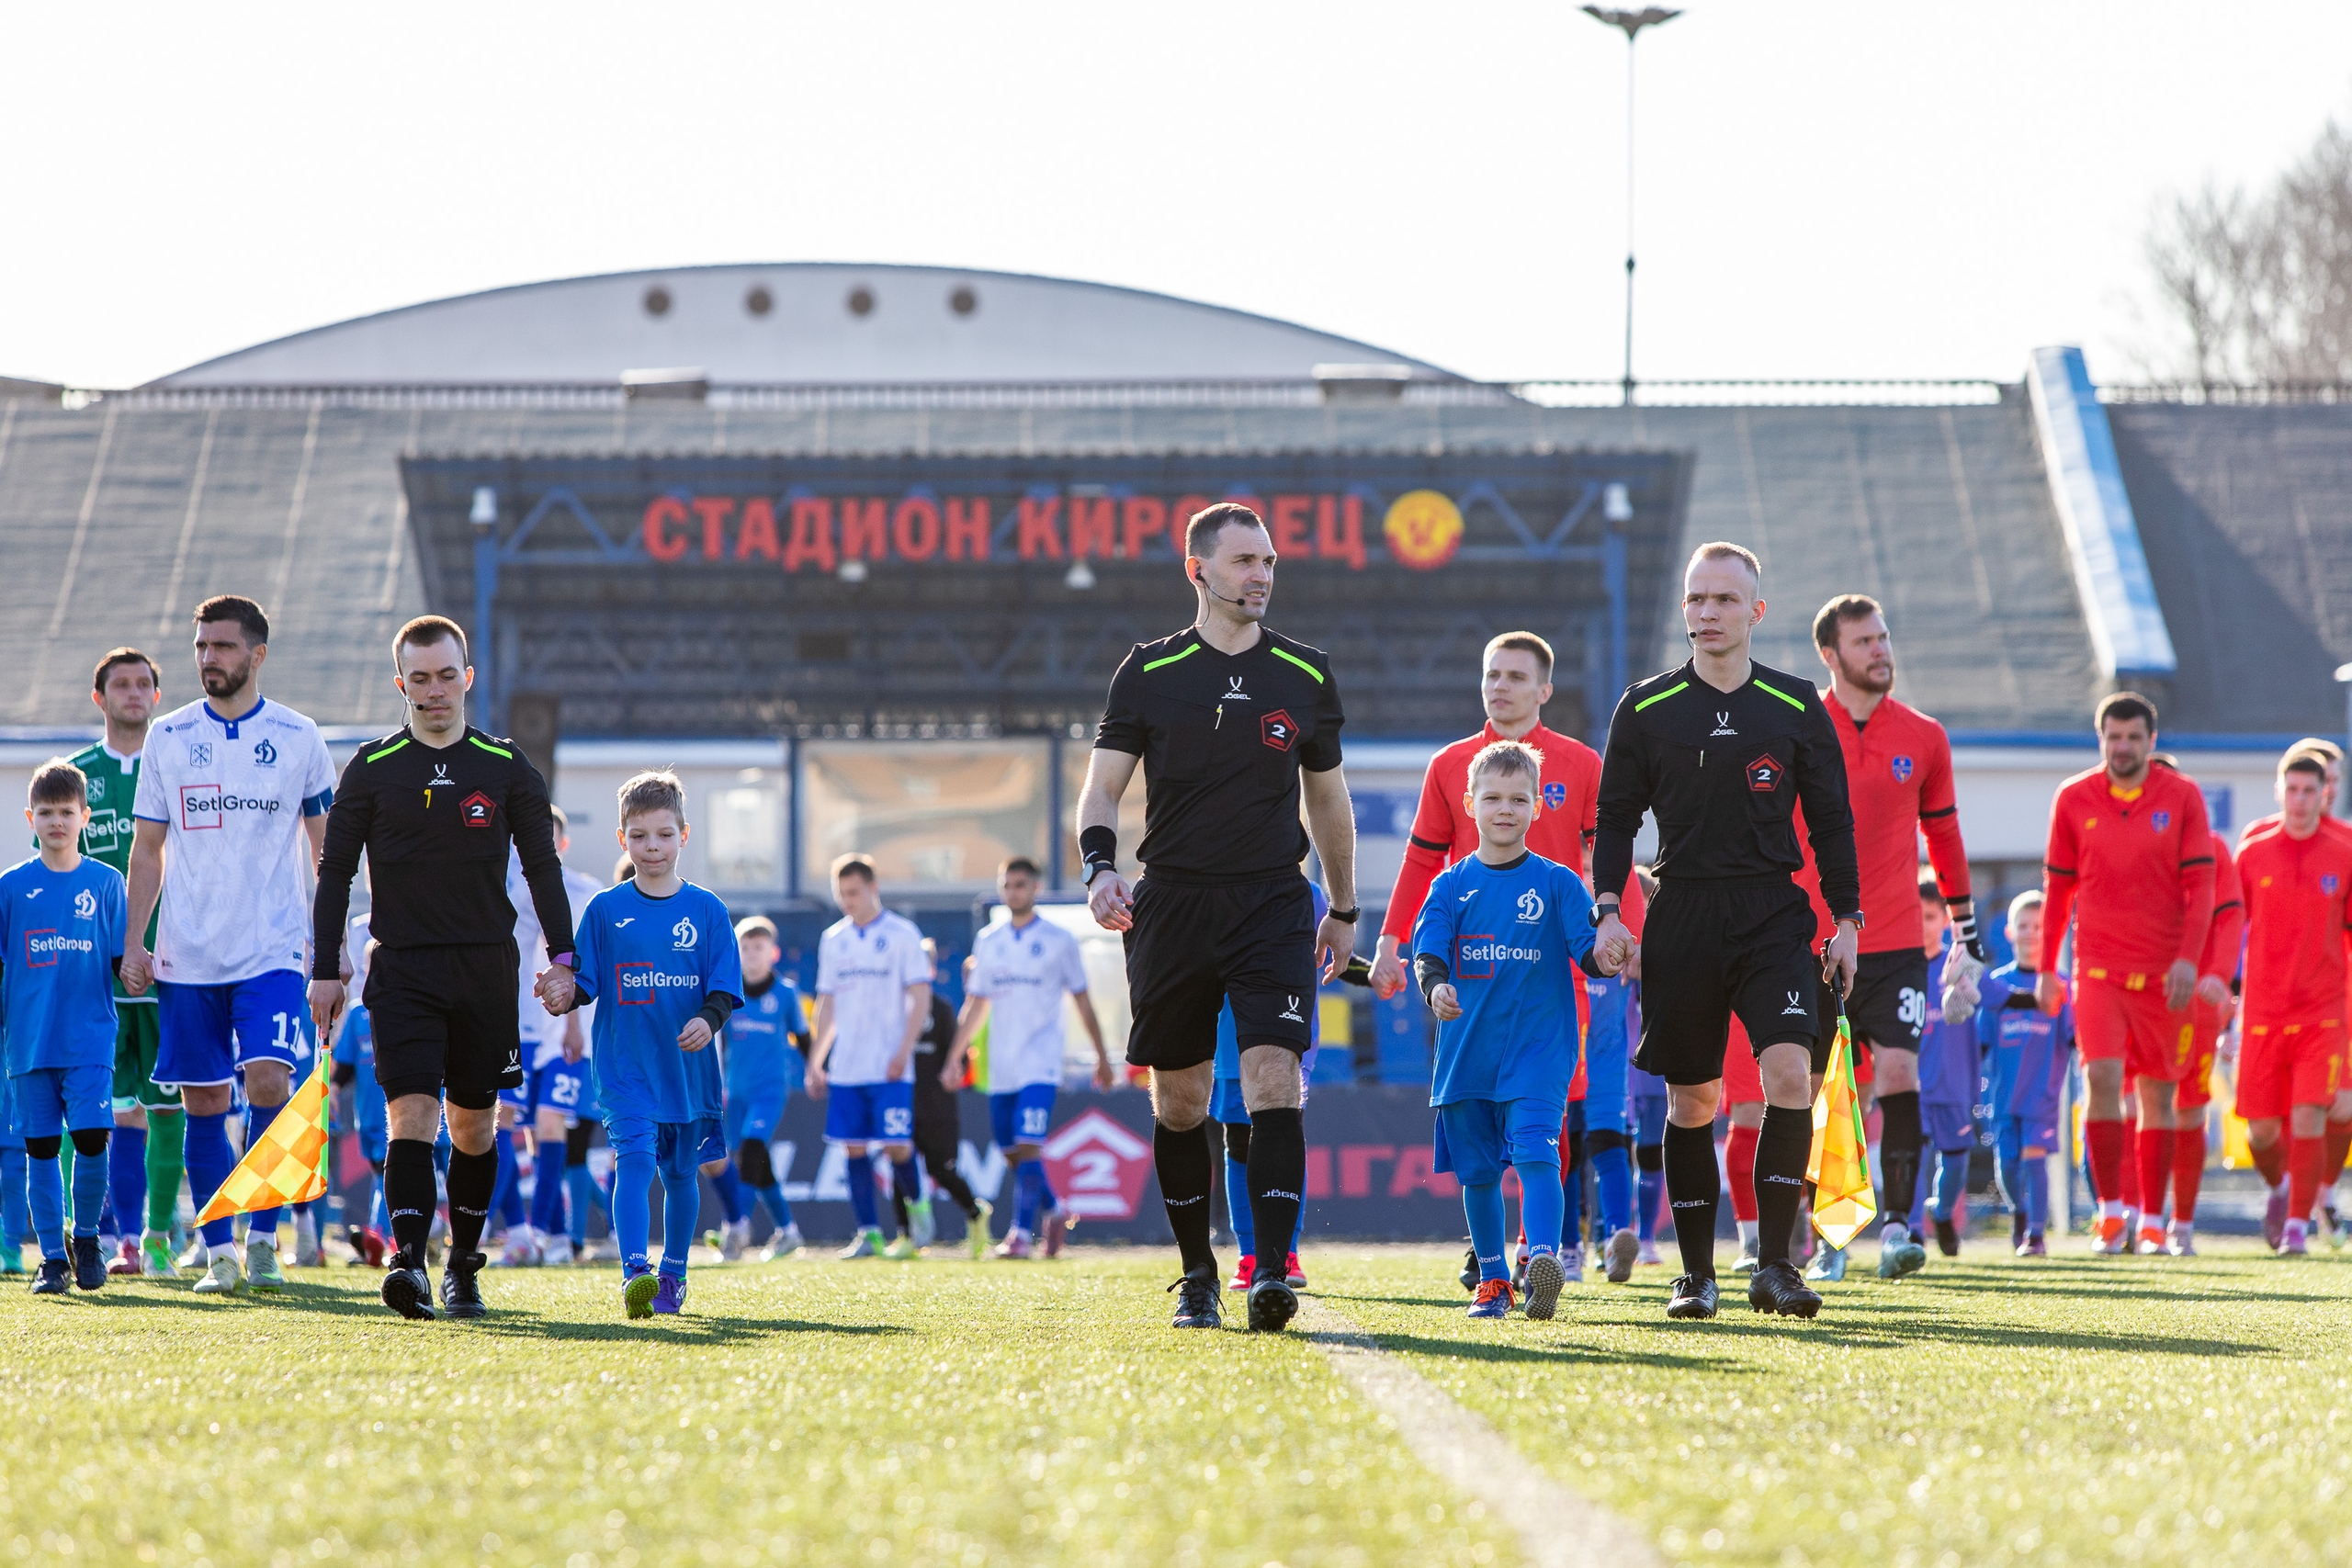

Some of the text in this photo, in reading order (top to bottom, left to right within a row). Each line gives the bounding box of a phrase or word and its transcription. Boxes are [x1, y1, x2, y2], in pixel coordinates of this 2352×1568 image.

[643, 496, 990, 571] СТАДИОН
[1271, 724, 1286, 739] 2
[1757, 769, 1771, 781] 2
[471, 805, 484, 817] 2
[1897, 987, 1926, 1028] 30
[271, 1011, 300, 1054] 11
[551, 1073, 582, 1107] 23
[884, 1107, 912, 1136] 52
[1068, 1150, 1121, 1191] 2
[1763, 1175, 1803, 1186] JÖGEL
[1261, 1189, 1300, 1202] JÖGEL
[1671, 1200, 1710, 1208] JÖGEL
[390, 1208, 423, 1221] JÖGEL
